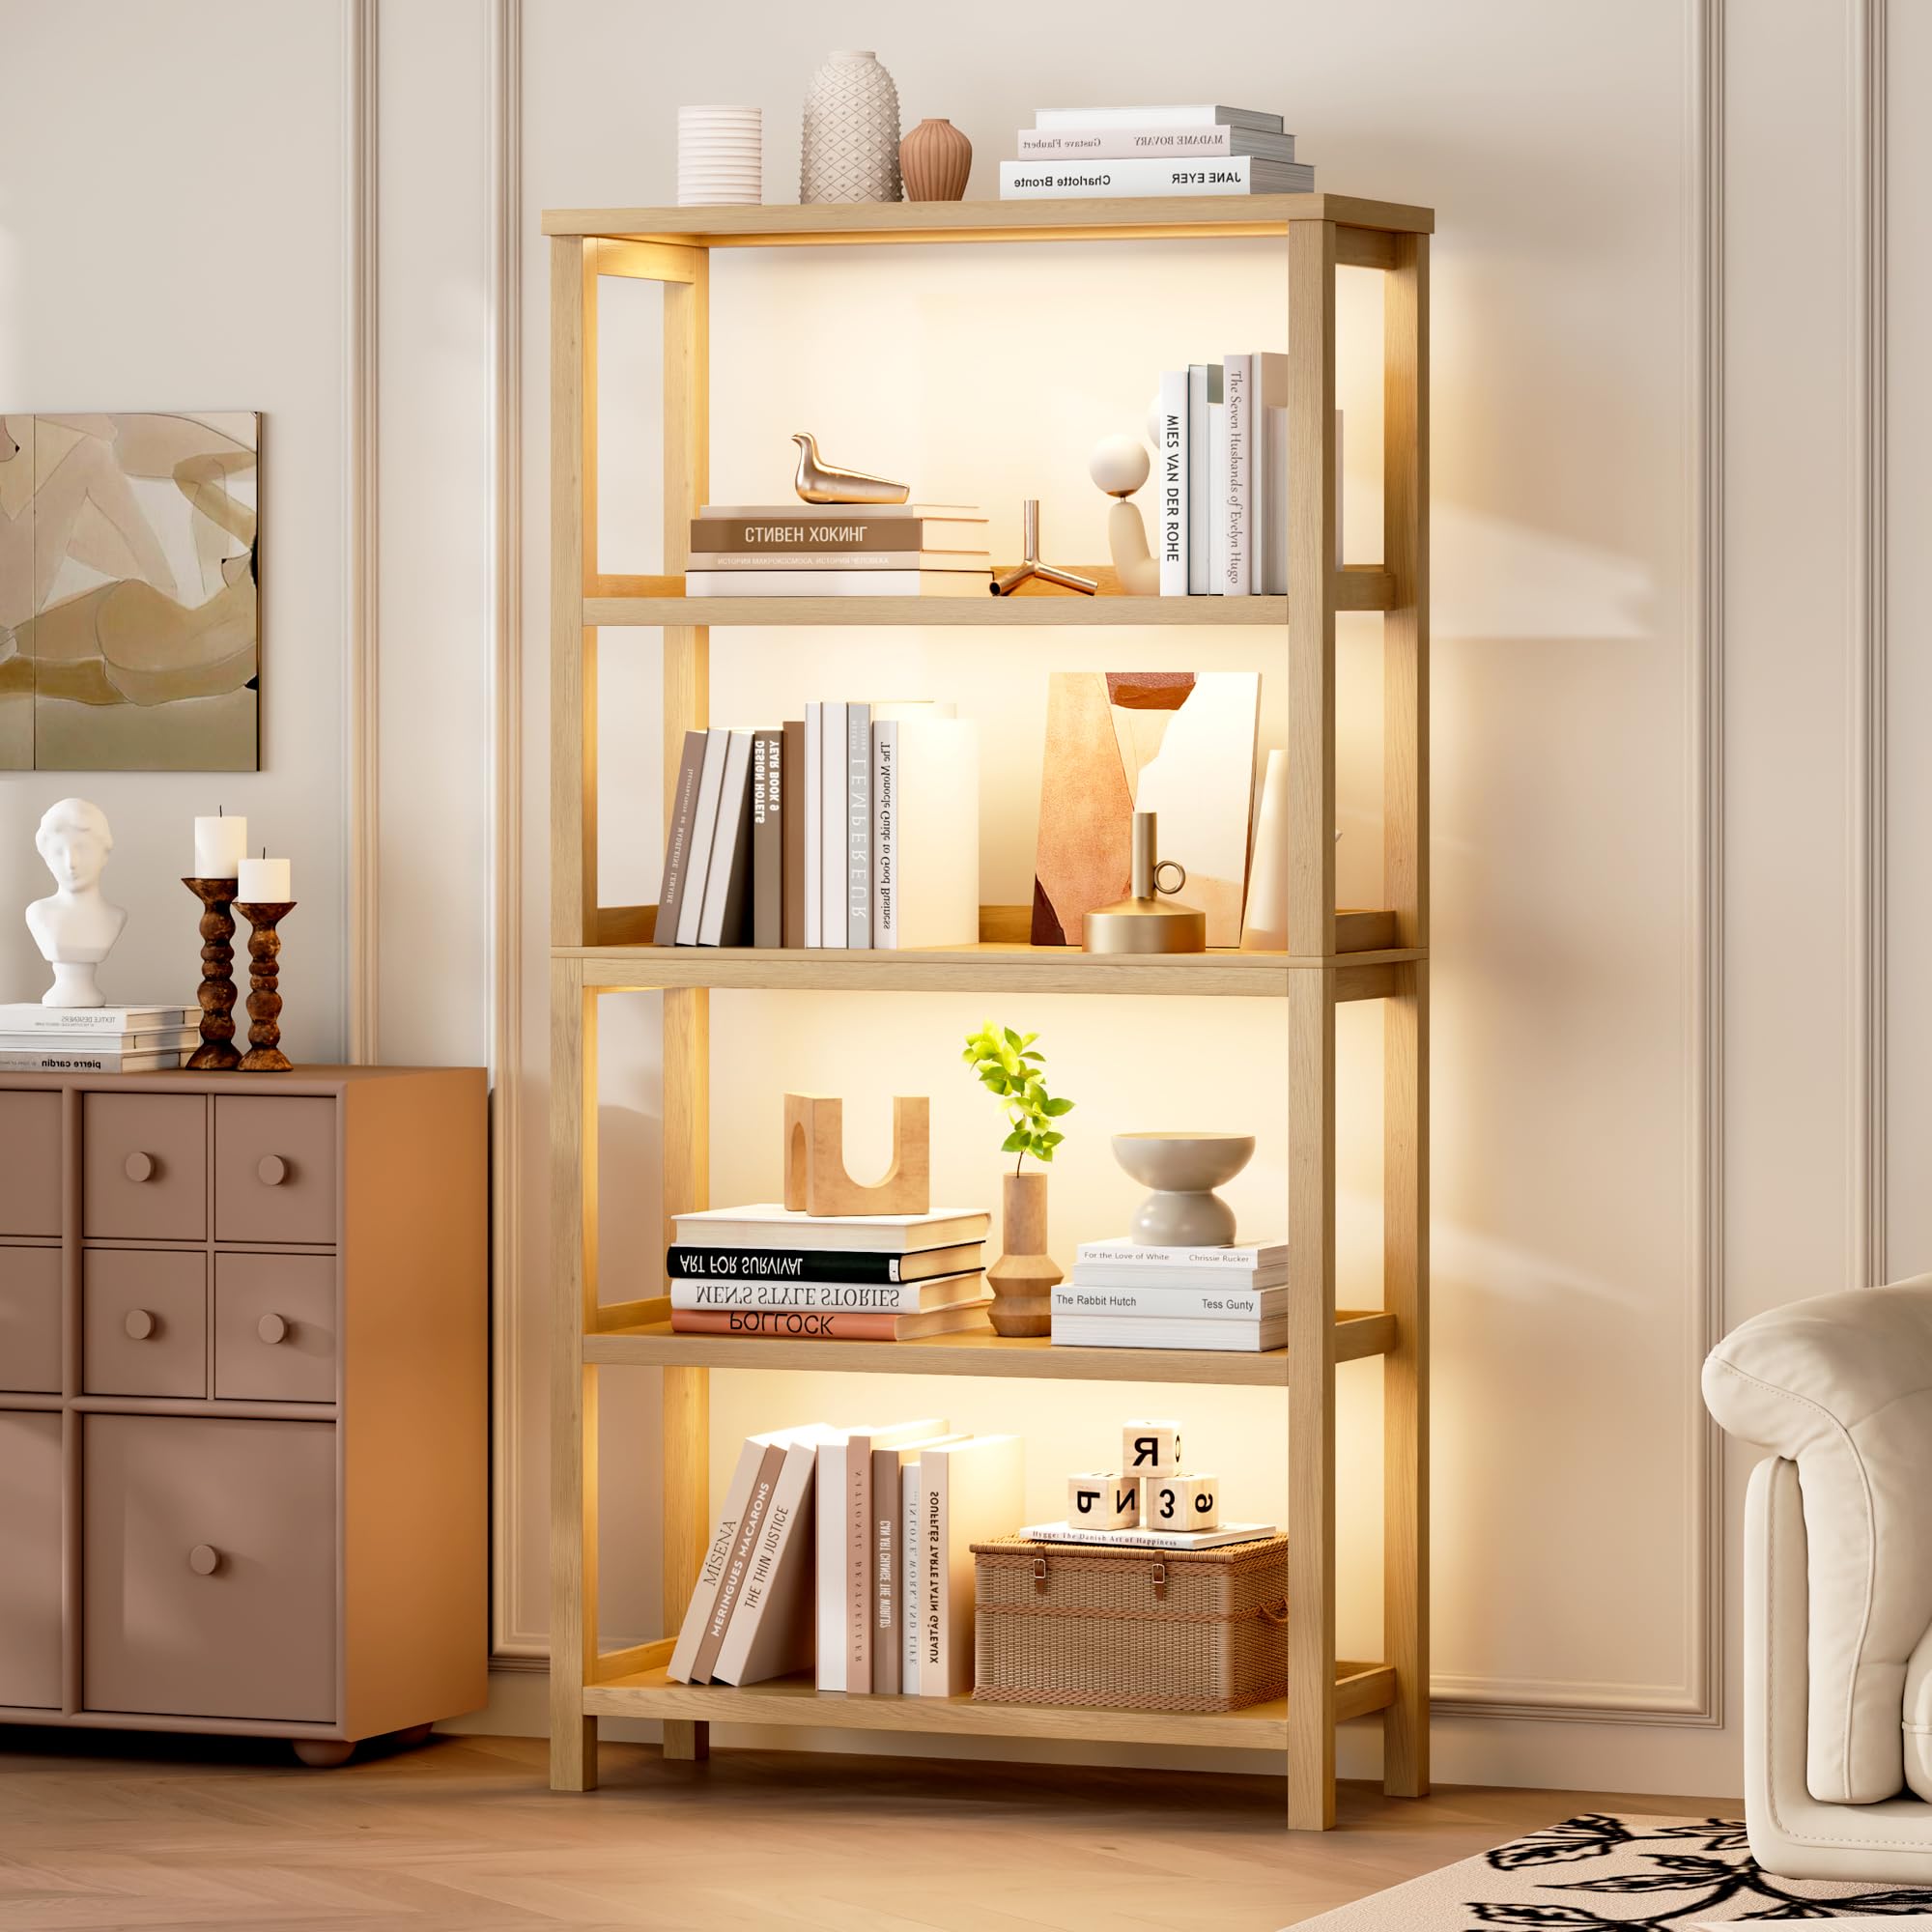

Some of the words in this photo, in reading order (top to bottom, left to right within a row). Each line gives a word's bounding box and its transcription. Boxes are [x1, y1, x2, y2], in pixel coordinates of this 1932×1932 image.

[1230, 371, 1242, 393] The
[1230, 394, 1241, 429] Seven
[1166, 414, 1179, 448] MIES
[1166, 454, 1179, 483] VAN
[1230, 432, 1243, 494] Husbands
[1166, 489, 1179, 517] DER
[1227, 496, 1242, 511] of
[745, 526, 805, 543] СТИВЕН
[809, 526, 868, 542] ХОКИНГ
[1166, 523, 1179, 562] ROHE
[1227, 512, 1243, 549] Evelyn
[1226, 552, 1242, 584] Hugo
[1188, 1253, 1220, 1263] Chrissie
[1055, 1293, 1073, 1305] The
[1076, 1294, 1107, 1306] Rabbit
[1109, 1295, 1137, 1307] Hutch
[1202, 1298, 1223, 1310] Tess
[1225, 1299, 1254, 1312] Gunty
[763, 1504, 790, 1553] JUSTICE
[1079, 1533, 1108, 1542] Danish
[1136, 1538, 1179, 1547] Happiness
[711, 1560, 743, 1637] MERINGUES
[739, 1482, 771, 1557] MACARONS
[753, 1553, 772, 1586] THIN
[744, 1584, 763, 1609] THE
